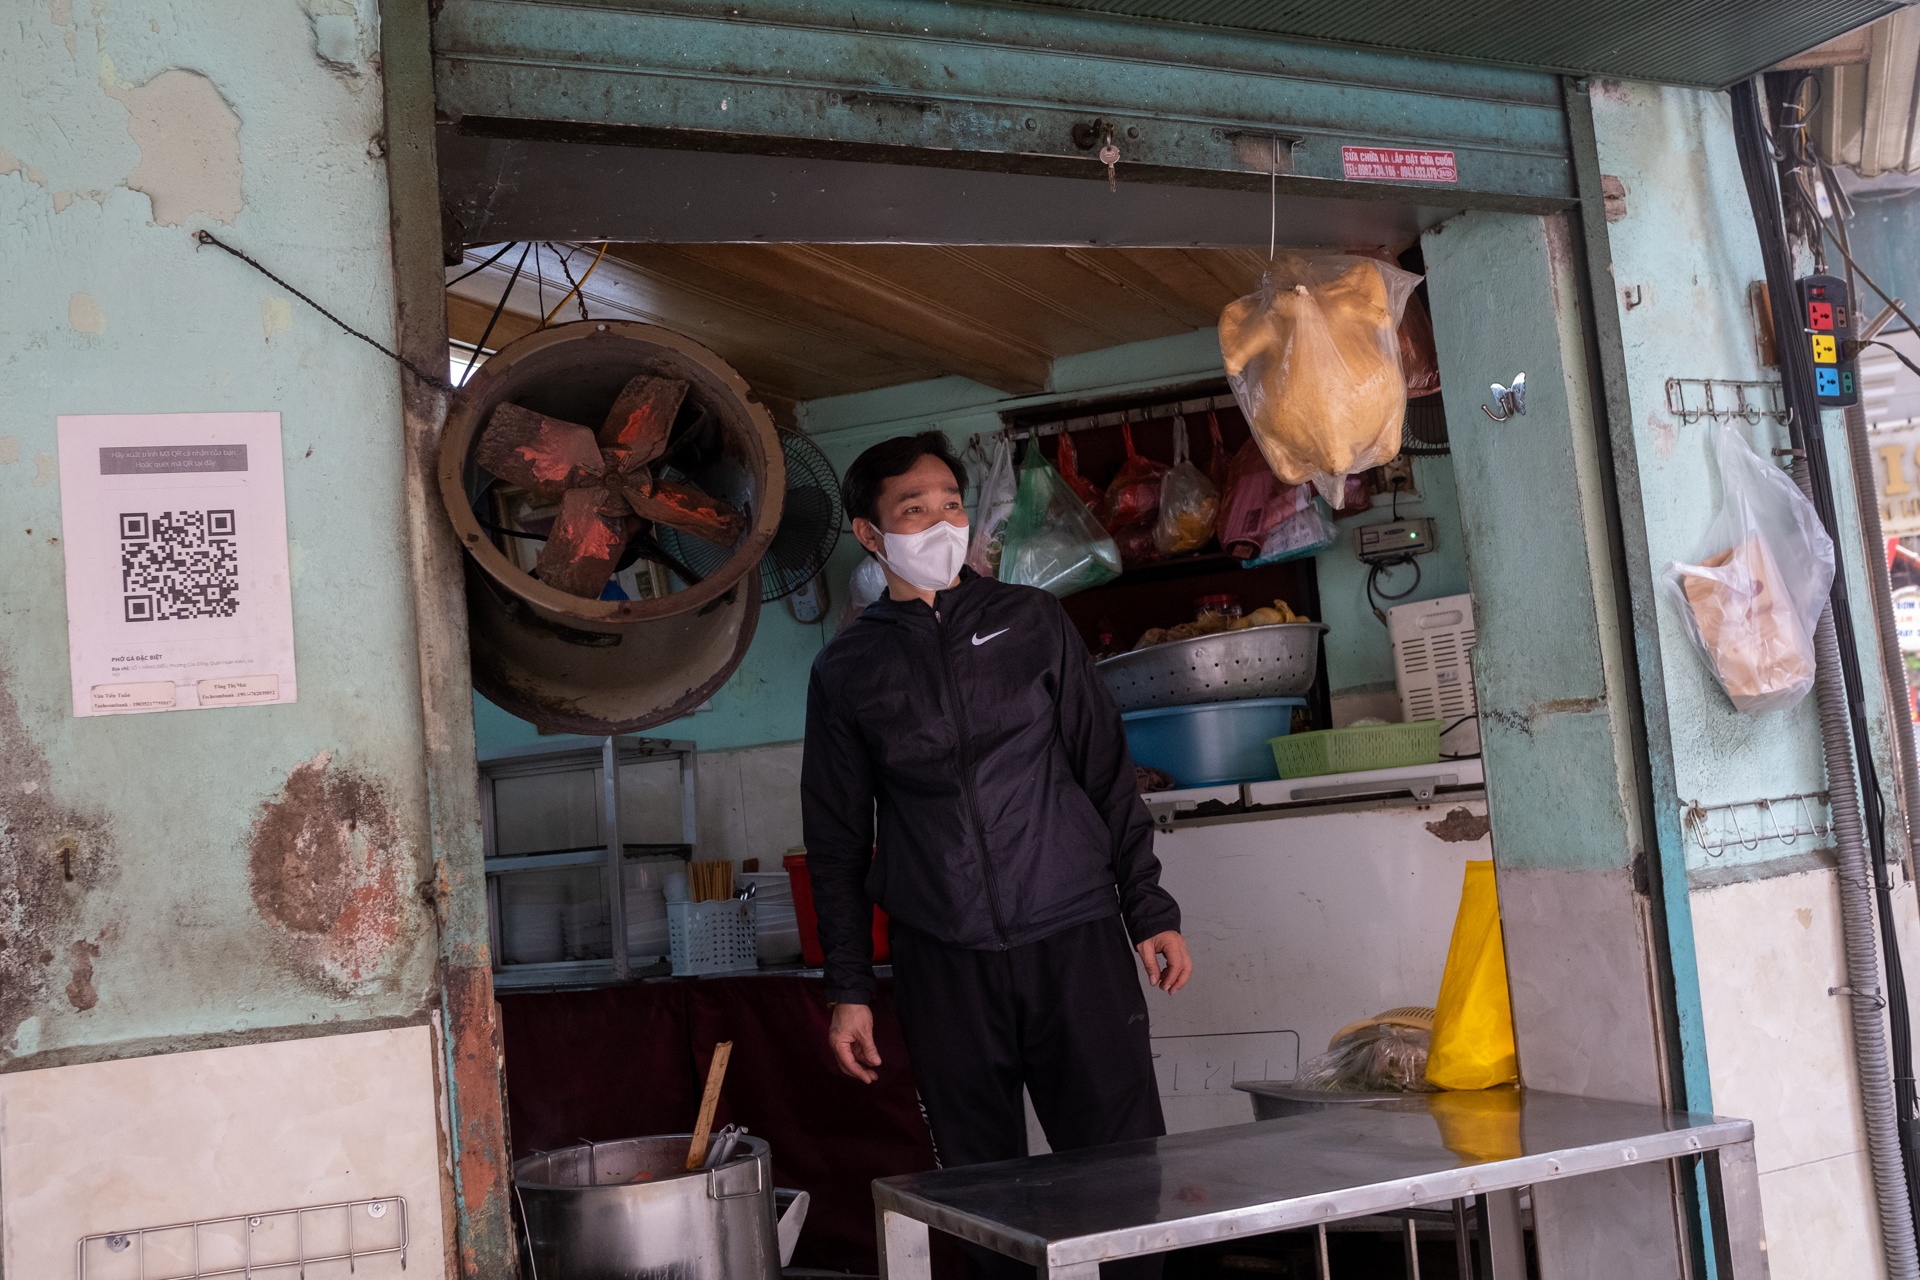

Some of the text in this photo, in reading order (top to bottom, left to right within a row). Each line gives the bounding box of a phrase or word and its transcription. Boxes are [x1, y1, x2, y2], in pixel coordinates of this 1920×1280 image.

[1344, 148, 1359, 161] SỬA
[1360, 150, 1379, 162] CHỮA
[1380, 152, 1390, 163] VÀ
[1420, 152, 1434, 166] CỬA
[1435, 154, 1453, 166] CUỐN
[171, 450, 182, 458] QR
[126, 654, 135, 662] GÀ
[136, 654, 148, 662] ĐẶC
